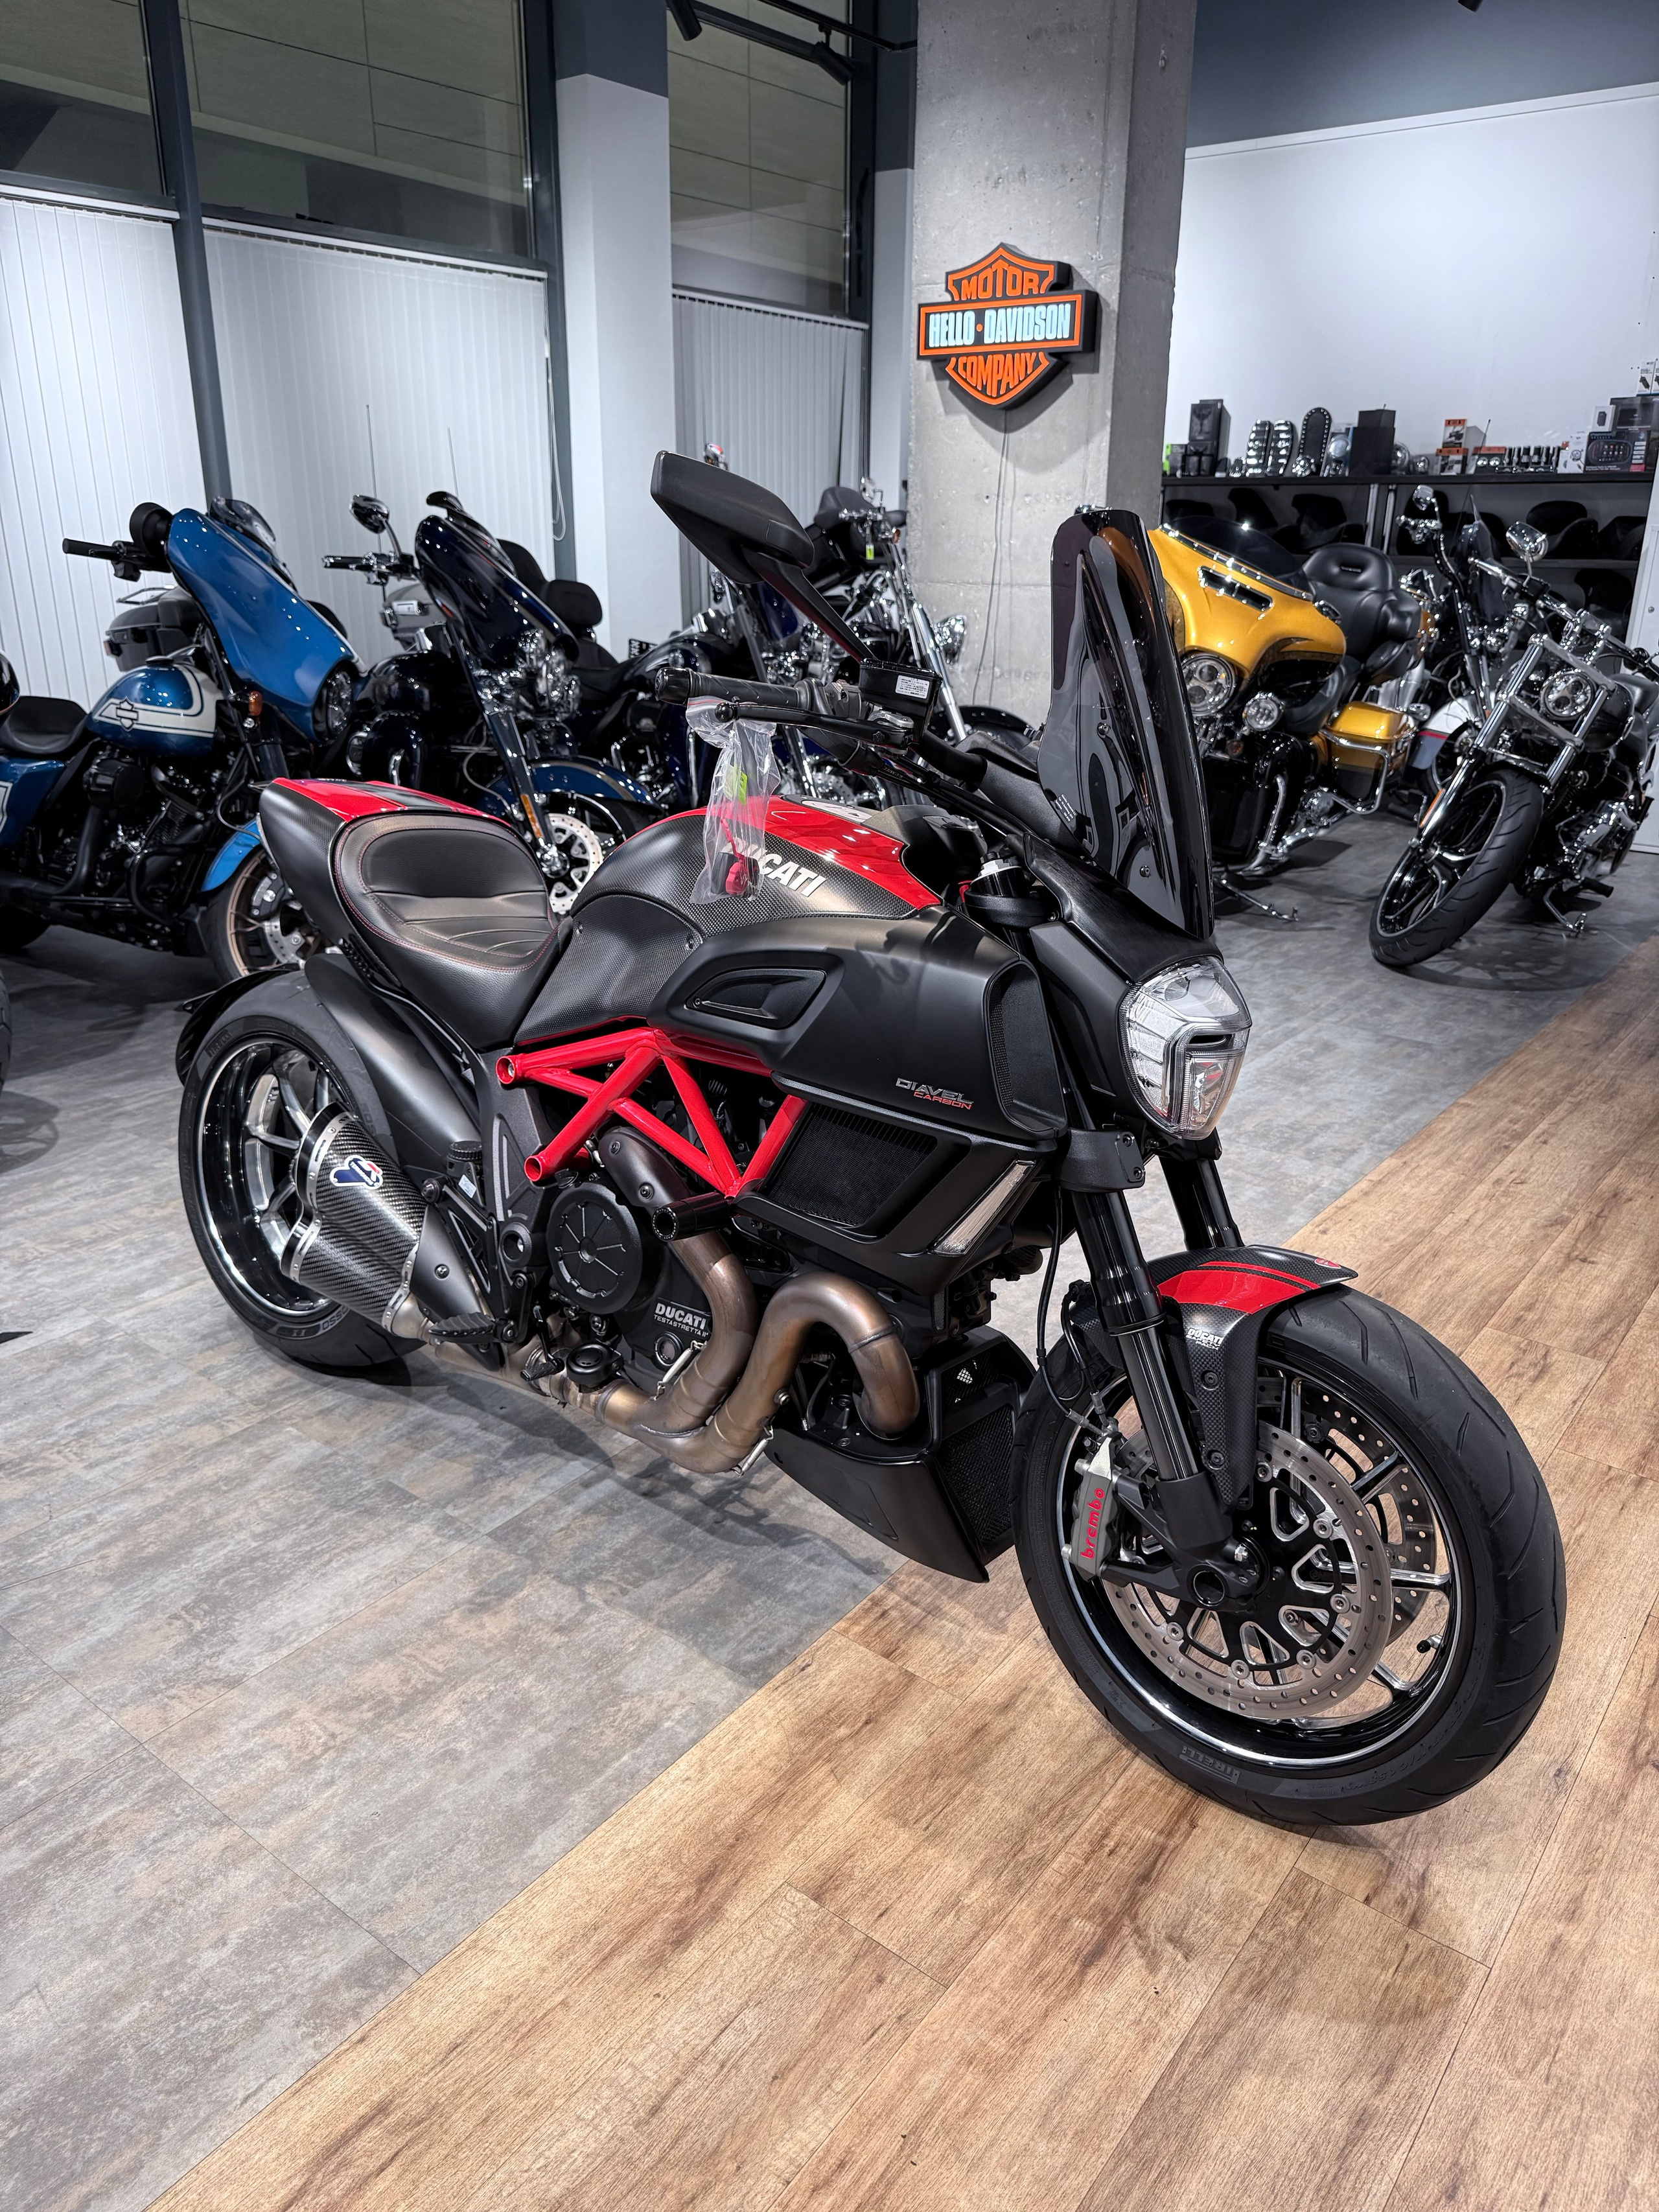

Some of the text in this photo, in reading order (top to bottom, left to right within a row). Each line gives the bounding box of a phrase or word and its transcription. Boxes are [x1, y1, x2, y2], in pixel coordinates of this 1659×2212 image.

[961, 259, 1040, 300] MOTOR
[929, 303, 1071, 347] HELLO DAVIDSON
[958, 352, 1037, 397] COMPANY
[895, 1077, 975, 1104] DIAVEL
[913, 1091, 973, 1110] CARBON
[654, 1315, 701, 1336] TESTASTRETTA
[655, 1303, 706, 1329] DUCATI
[1187, 1327, 1224, 1345] DUCATI
[1195, 1340, 1219, 1351] PACK
[1080, 1487, 1105, 1559] brembo
[1179, 1745, 1241, 1784] PIRELLI
